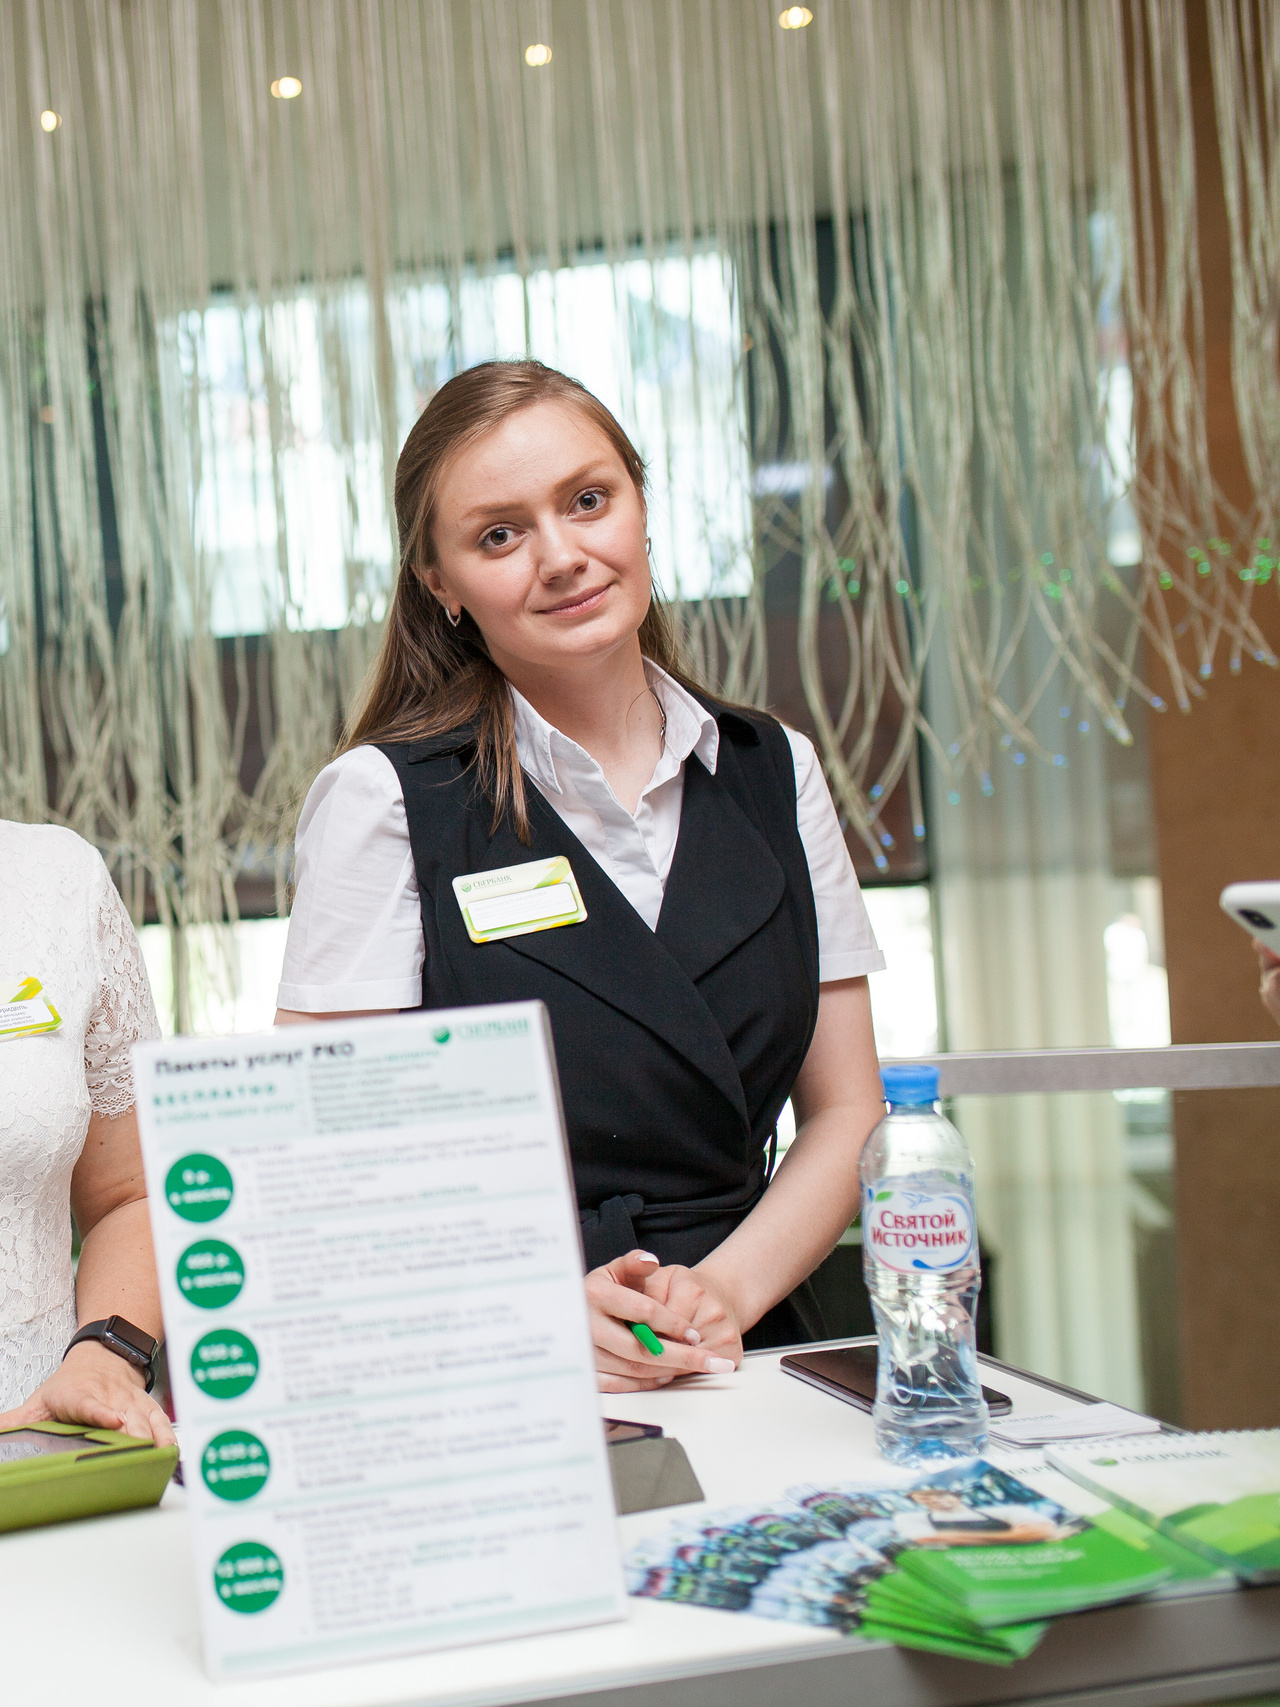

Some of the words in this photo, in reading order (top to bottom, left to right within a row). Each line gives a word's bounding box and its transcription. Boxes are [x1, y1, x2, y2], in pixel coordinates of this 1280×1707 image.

[473, 875, 512, 888] СБЕРБАНК
[155, 1057, 238, 1075] Пакеты
[245, 1050, 303, 1069] услуг
[312, 1040, 355, 1058] РКО
[880, 1208, 956, 1229] Святой
[872, 1226, 968, 1248] Источник
[1121, 1448, 1233, 1464] СБЕРБАНК
